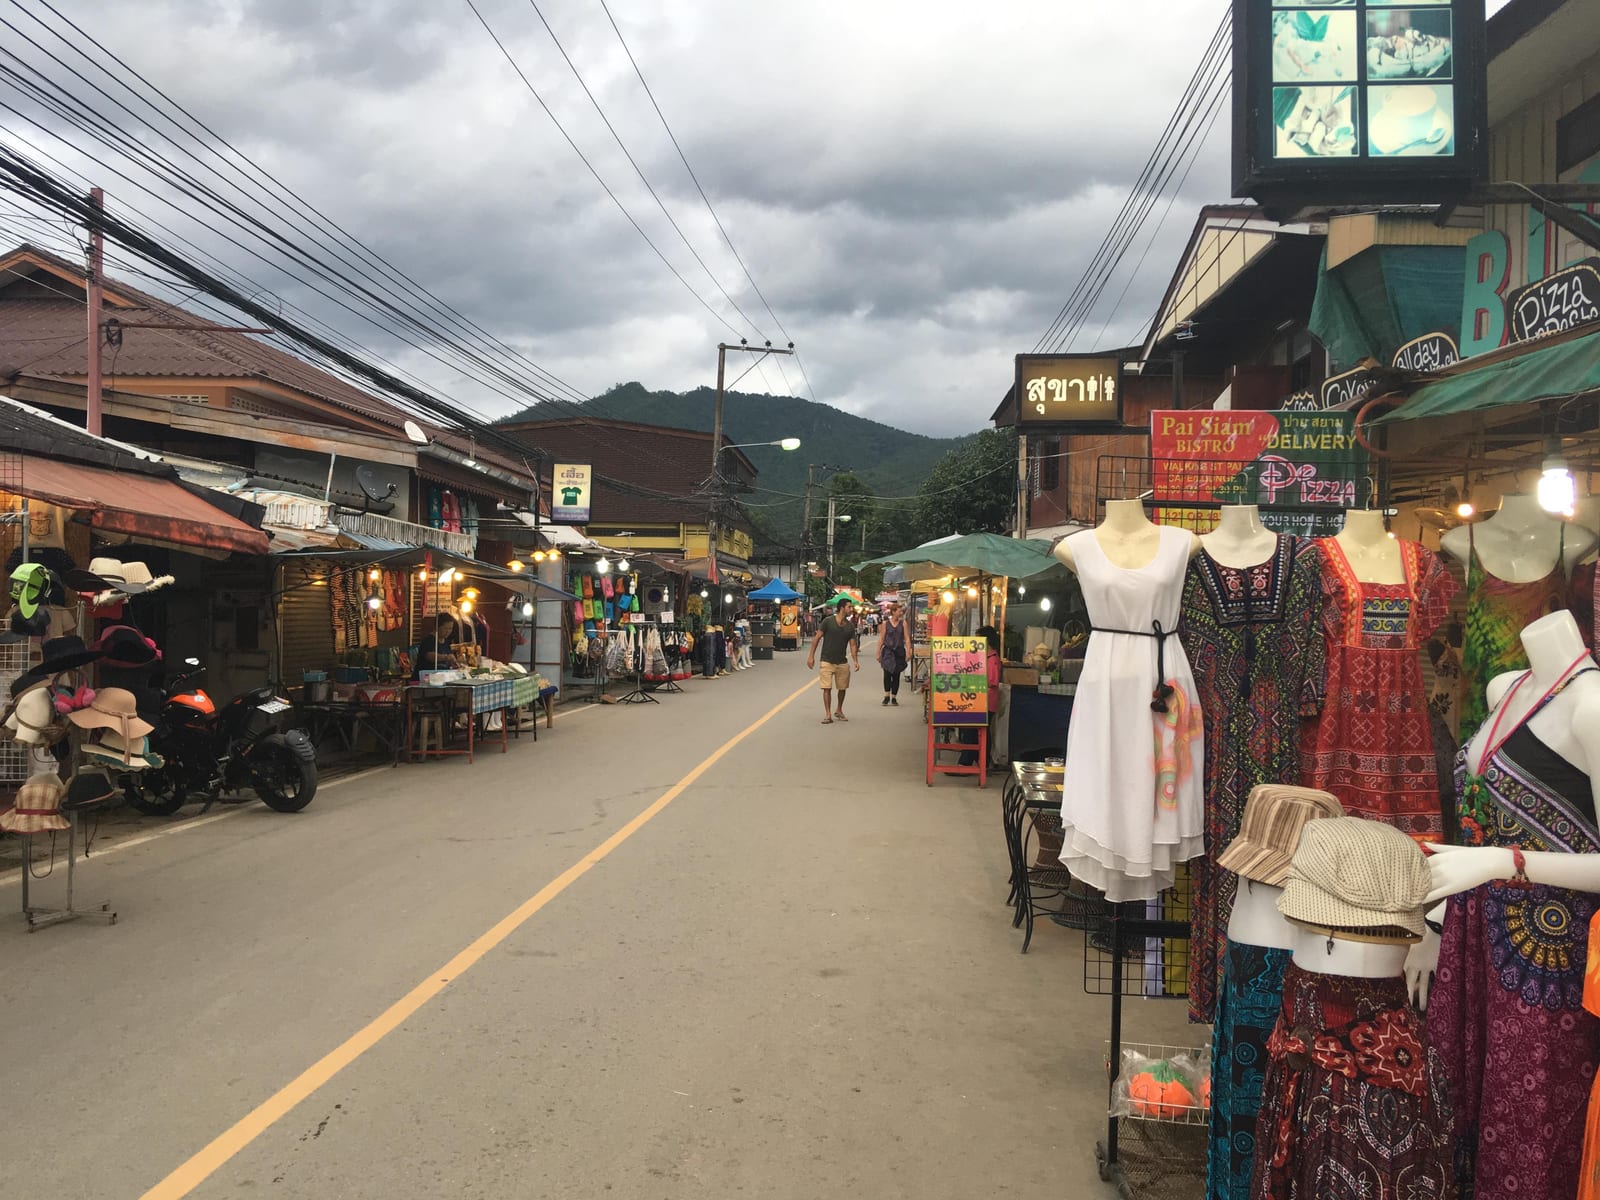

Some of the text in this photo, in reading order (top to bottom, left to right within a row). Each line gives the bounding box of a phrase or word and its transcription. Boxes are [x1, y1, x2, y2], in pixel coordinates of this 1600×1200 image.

[1519, 275, 1592, 339] Pizza
[1414, 338, 1440, 370] day
[1026, 376, 1085, 415] สุขา
[1161, 416, 1251, 436] Pai Siam
[1311, 417, 1344, 429] สยาม
[1176, 439, 1236, 454] BISTRO
[1260, 514, 1290, 526] YOUR
[933, 640, 985, 653] Mixed 30
[935, 652, 960, 664] Fruit
[953, 661, 983, 674] Shake
[960, 691, 977, 701] No
